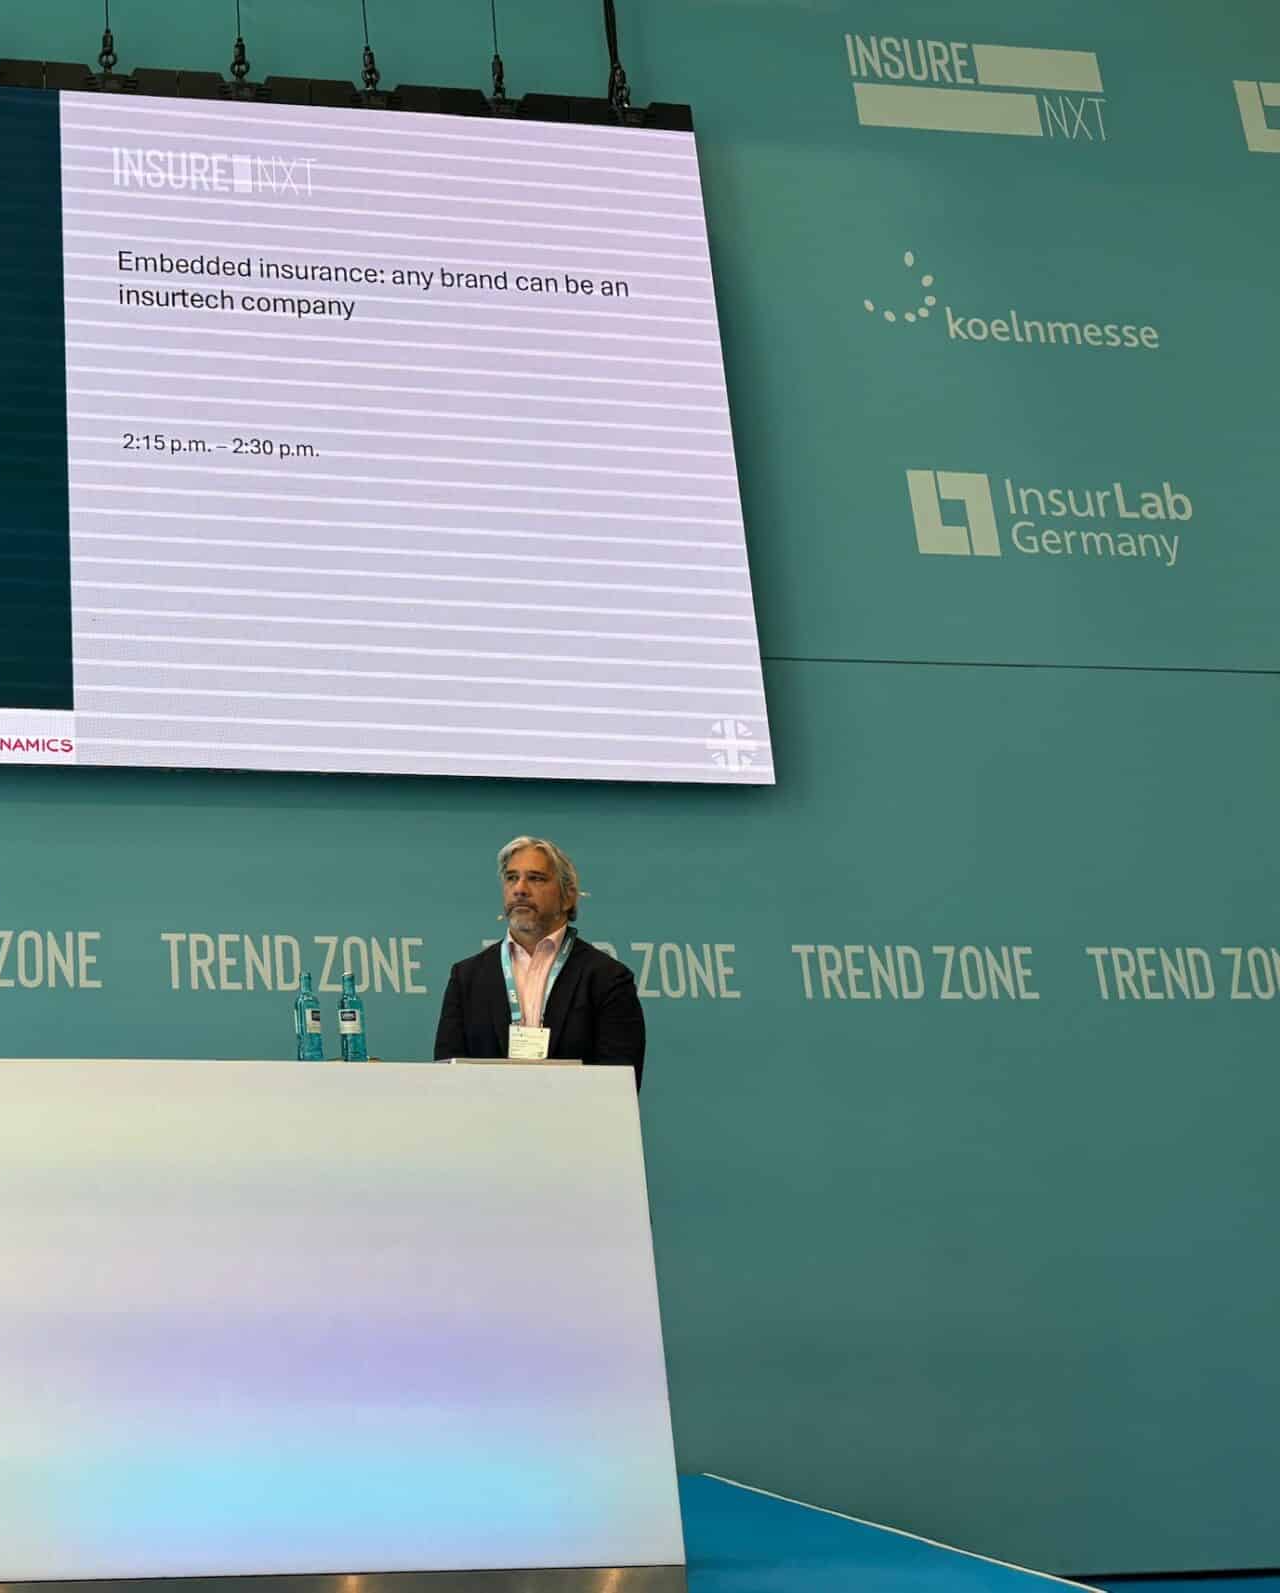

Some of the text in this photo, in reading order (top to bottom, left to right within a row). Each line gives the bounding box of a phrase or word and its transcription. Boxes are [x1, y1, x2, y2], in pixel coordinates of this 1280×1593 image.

[845, 33, 975, 84] INSURE
[1042, 95, 1106, 142] NXT
[112, 148, 317, 196] INSURE NXT
[118, 251, 629, 297] Embedded insurance: any brand can be an
[119, 285, 356, 321] insurtech company
[945, 306, 1160, 349] koelnmesse
[123, 433, 166, 450] 2:15
[171, 439, 212, 454] p.m.
[232, 438, 274, 455] 2:30
[279, 443, 320, 459] p.m.
[1005, 479, 1193, 521] InsurLab
[1011, 521, 1179, 566] Germany
[160, 933, 302, 991] TREND
[314, 935, 428, 993] ZONE
[630, 942, 742, 998] ZONE
[791, 944, 1041, 1000] TREND ZONE
[1086, 946, 1216, 1000] TREND
